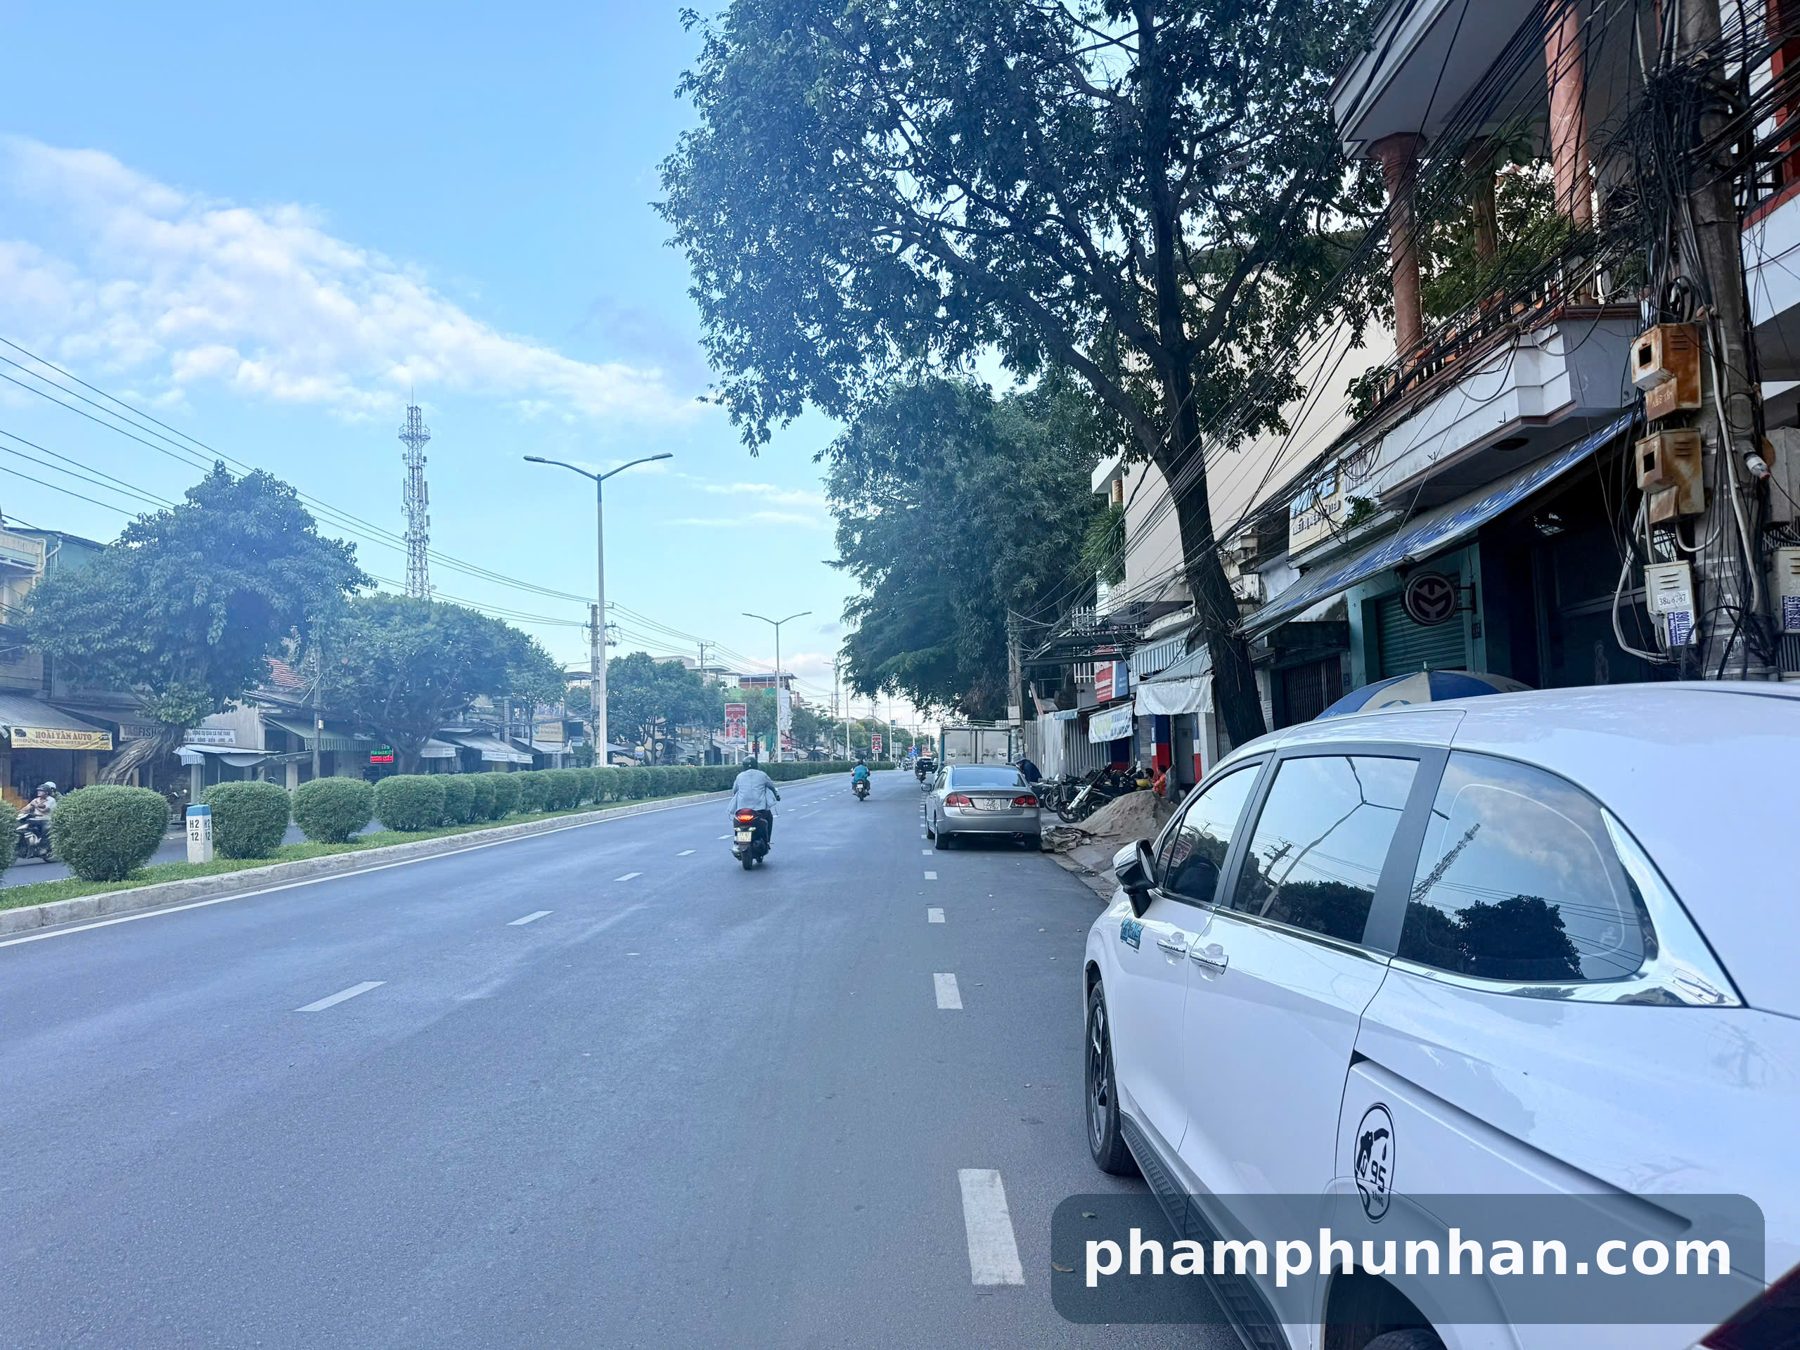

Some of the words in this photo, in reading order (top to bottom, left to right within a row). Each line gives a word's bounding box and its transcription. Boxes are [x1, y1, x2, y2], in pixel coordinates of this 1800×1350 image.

[73, 732, 92, 741] AUTO
[190, 820, 199, 828] H2
[191, 831, 199, 841] 12
[1370, 1160, 1386, 1193] 95
